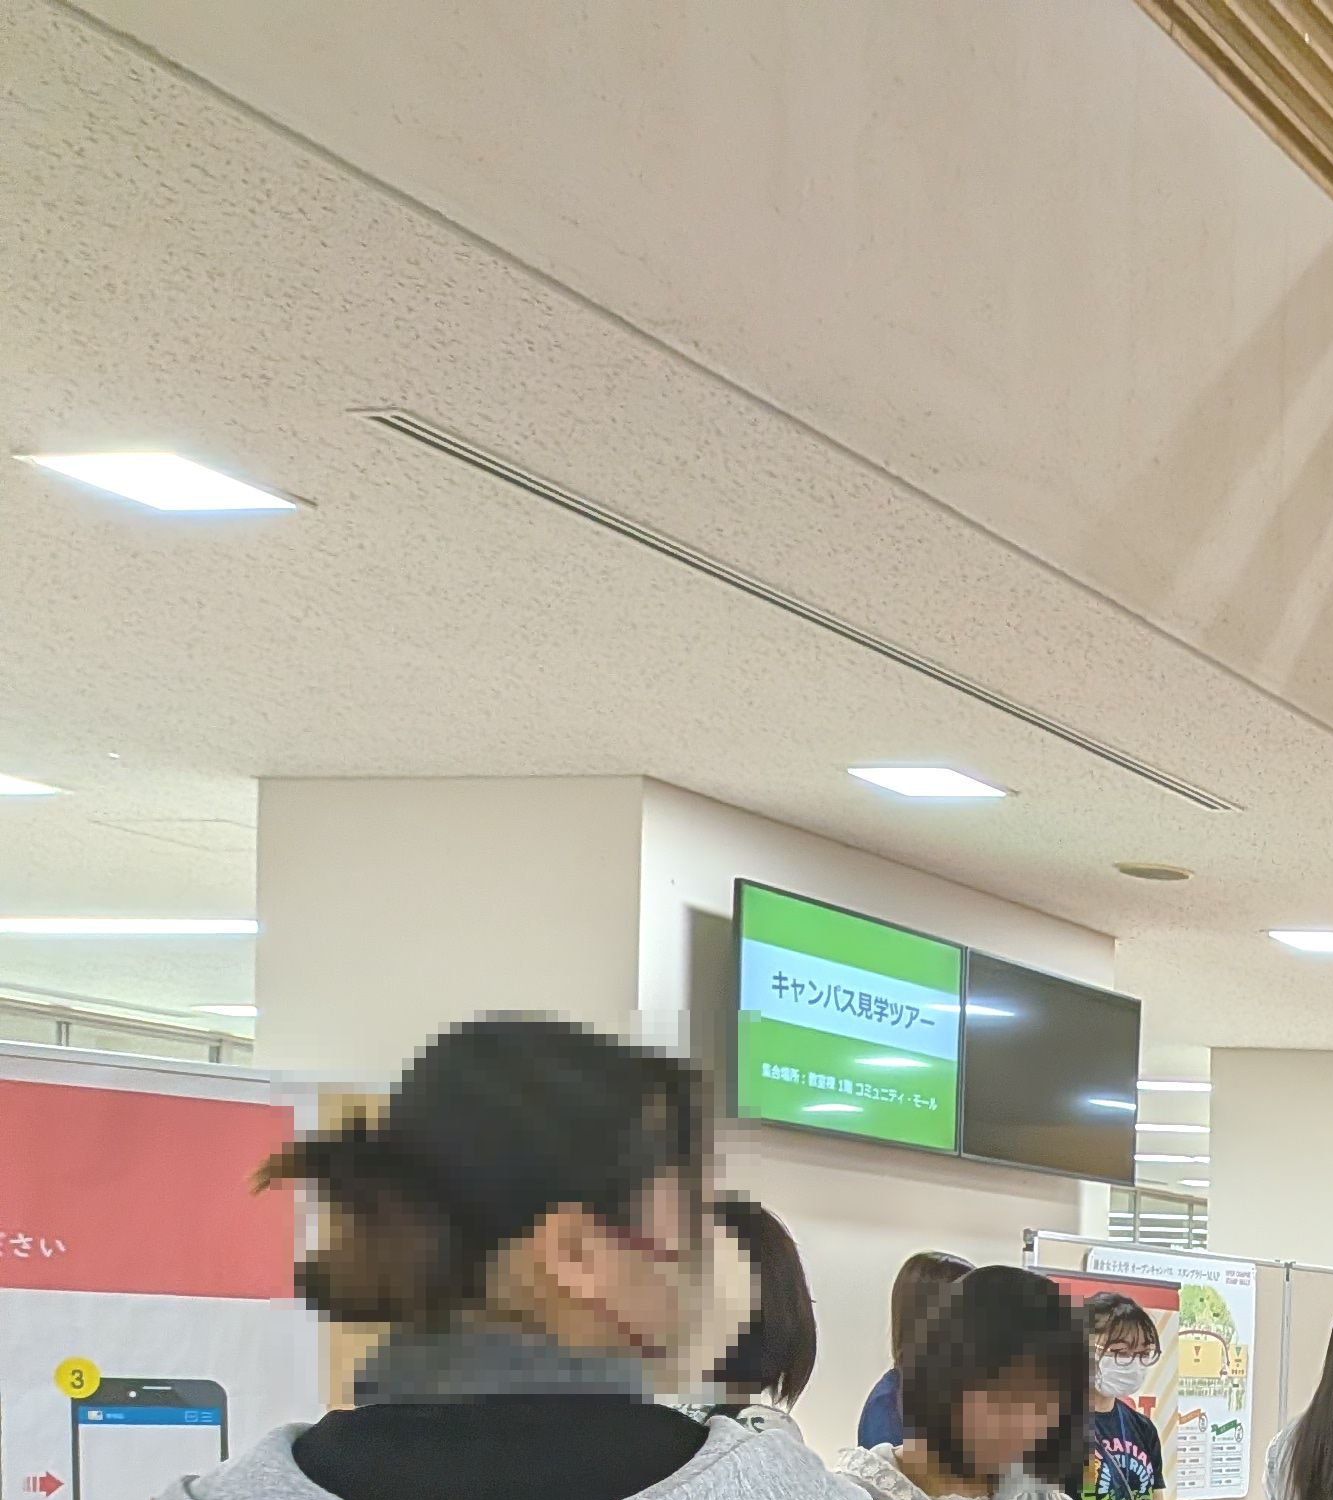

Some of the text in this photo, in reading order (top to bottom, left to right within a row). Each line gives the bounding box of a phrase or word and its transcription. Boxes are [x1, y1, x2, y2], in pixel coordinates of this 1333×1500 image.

[771, 970, 936, 1030] キャンパス見学ツアー
[0, 1232, 66, 1257] さい
[70, 1369, 85, 1389] 3
